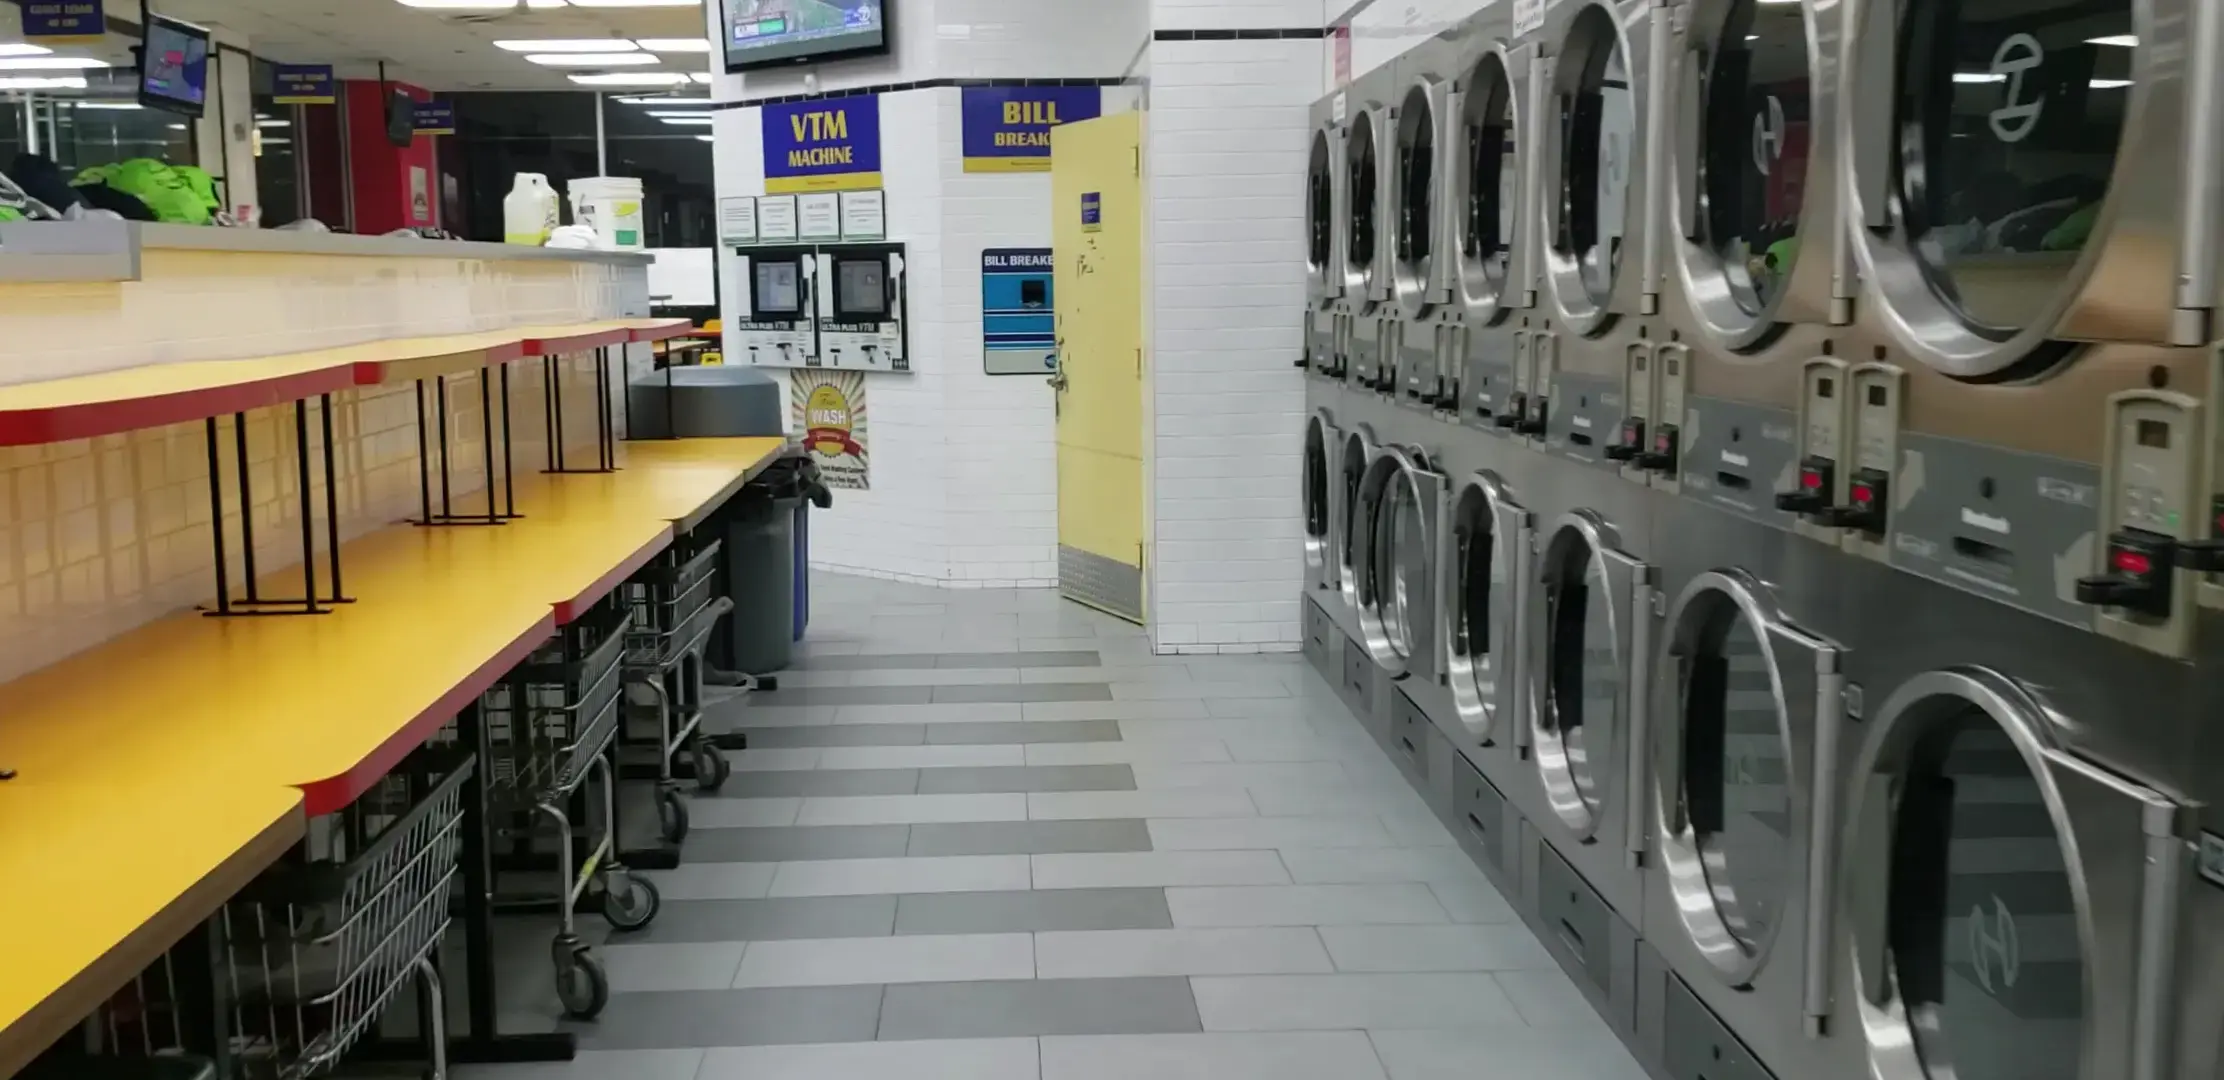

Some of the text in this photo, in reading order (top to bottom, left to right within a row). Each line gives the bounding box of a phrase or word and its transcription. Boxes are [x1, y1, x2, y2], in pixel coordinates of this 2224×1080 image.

[1003, 101, 1062, 125] BILL
[791, 110, 848, 142] VTM
[788, 146, 853, 169] MACHINE
[985, 256, 1008, 267] BILL
[812, 409, 846, 424] WASH
